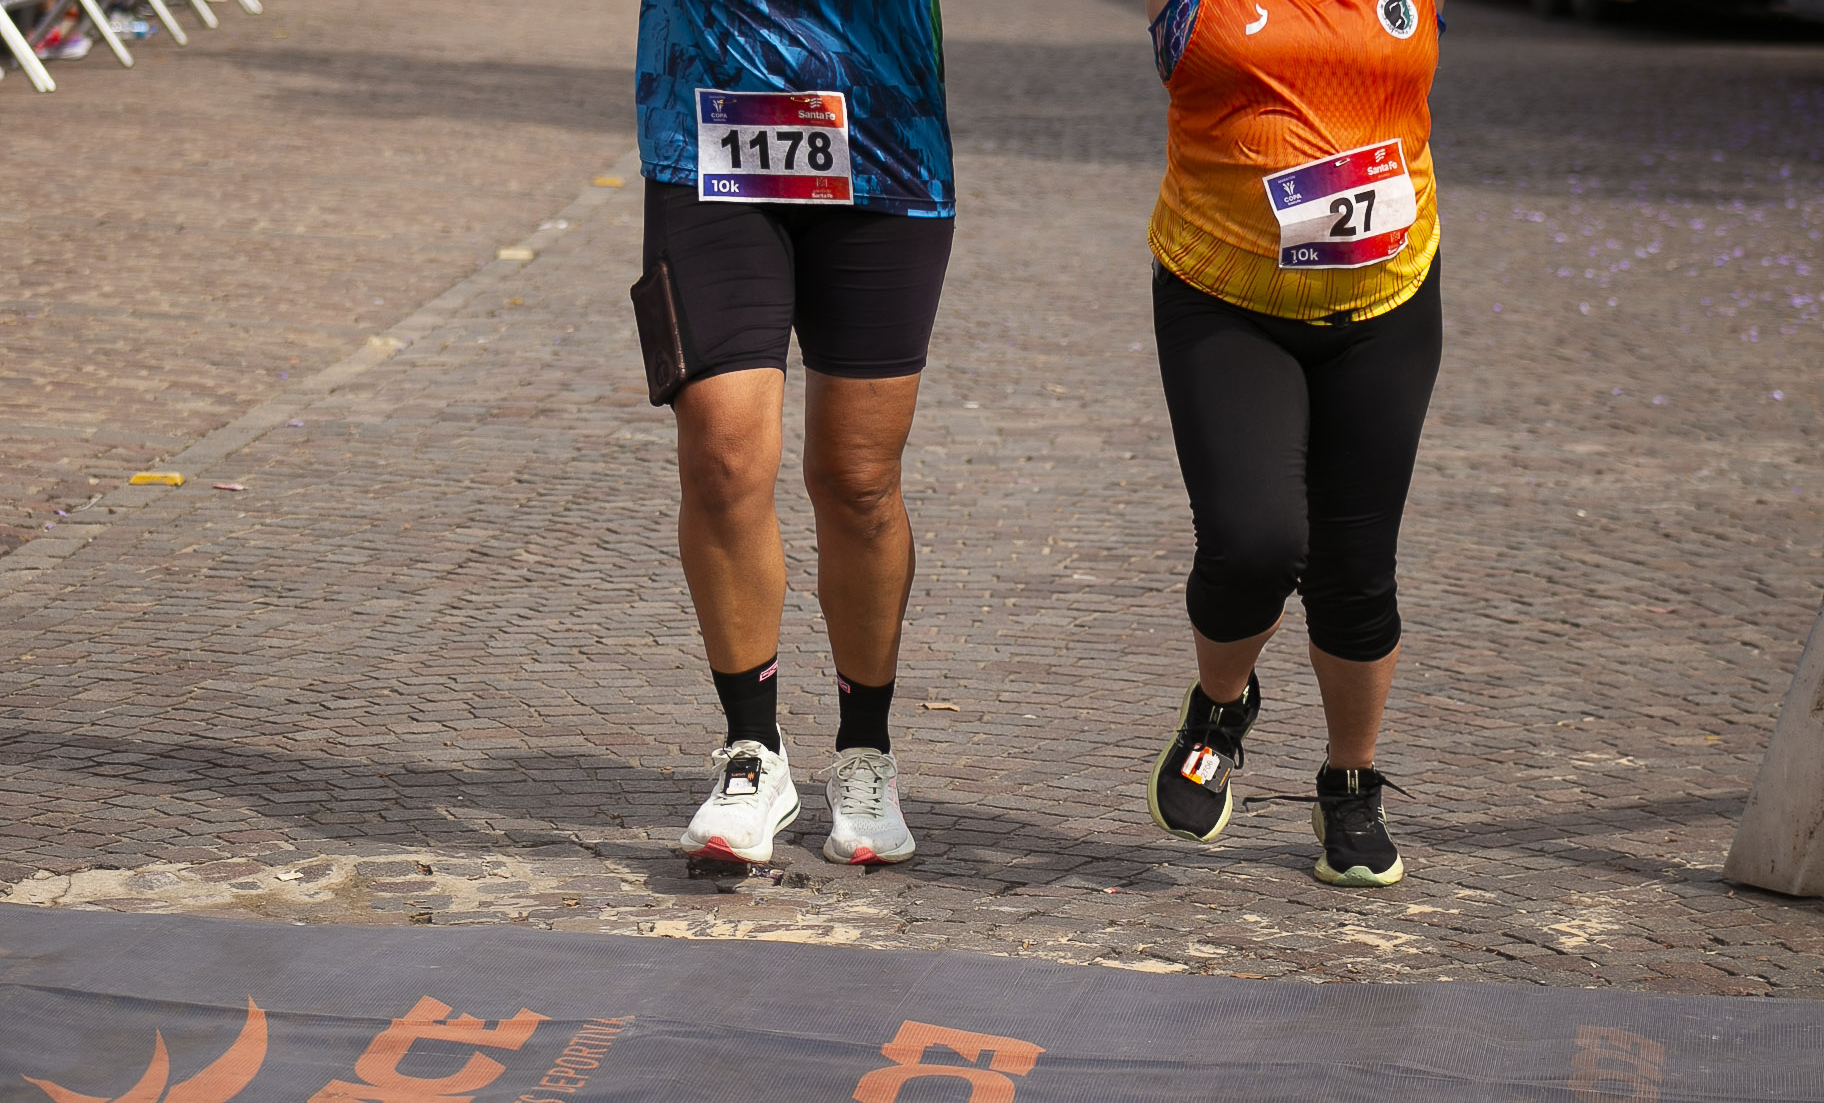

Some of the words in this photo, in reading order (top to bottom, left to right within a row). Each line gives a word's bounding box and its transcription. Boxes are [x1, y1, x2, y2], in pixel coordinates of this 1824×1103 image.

[798, 109, 825, 120] Santa
[720, 129, 834, 172] 1178
[1367, 164, 1387, 176] Santa
[711, 179, 740, 193] 10k
[1284, 194, 1302, 203] COPA
[1329, 189, 1376, 238] 27
[1290, 248, 1319, 264] 10k
[1201, 760, 1213, 779] 2706
